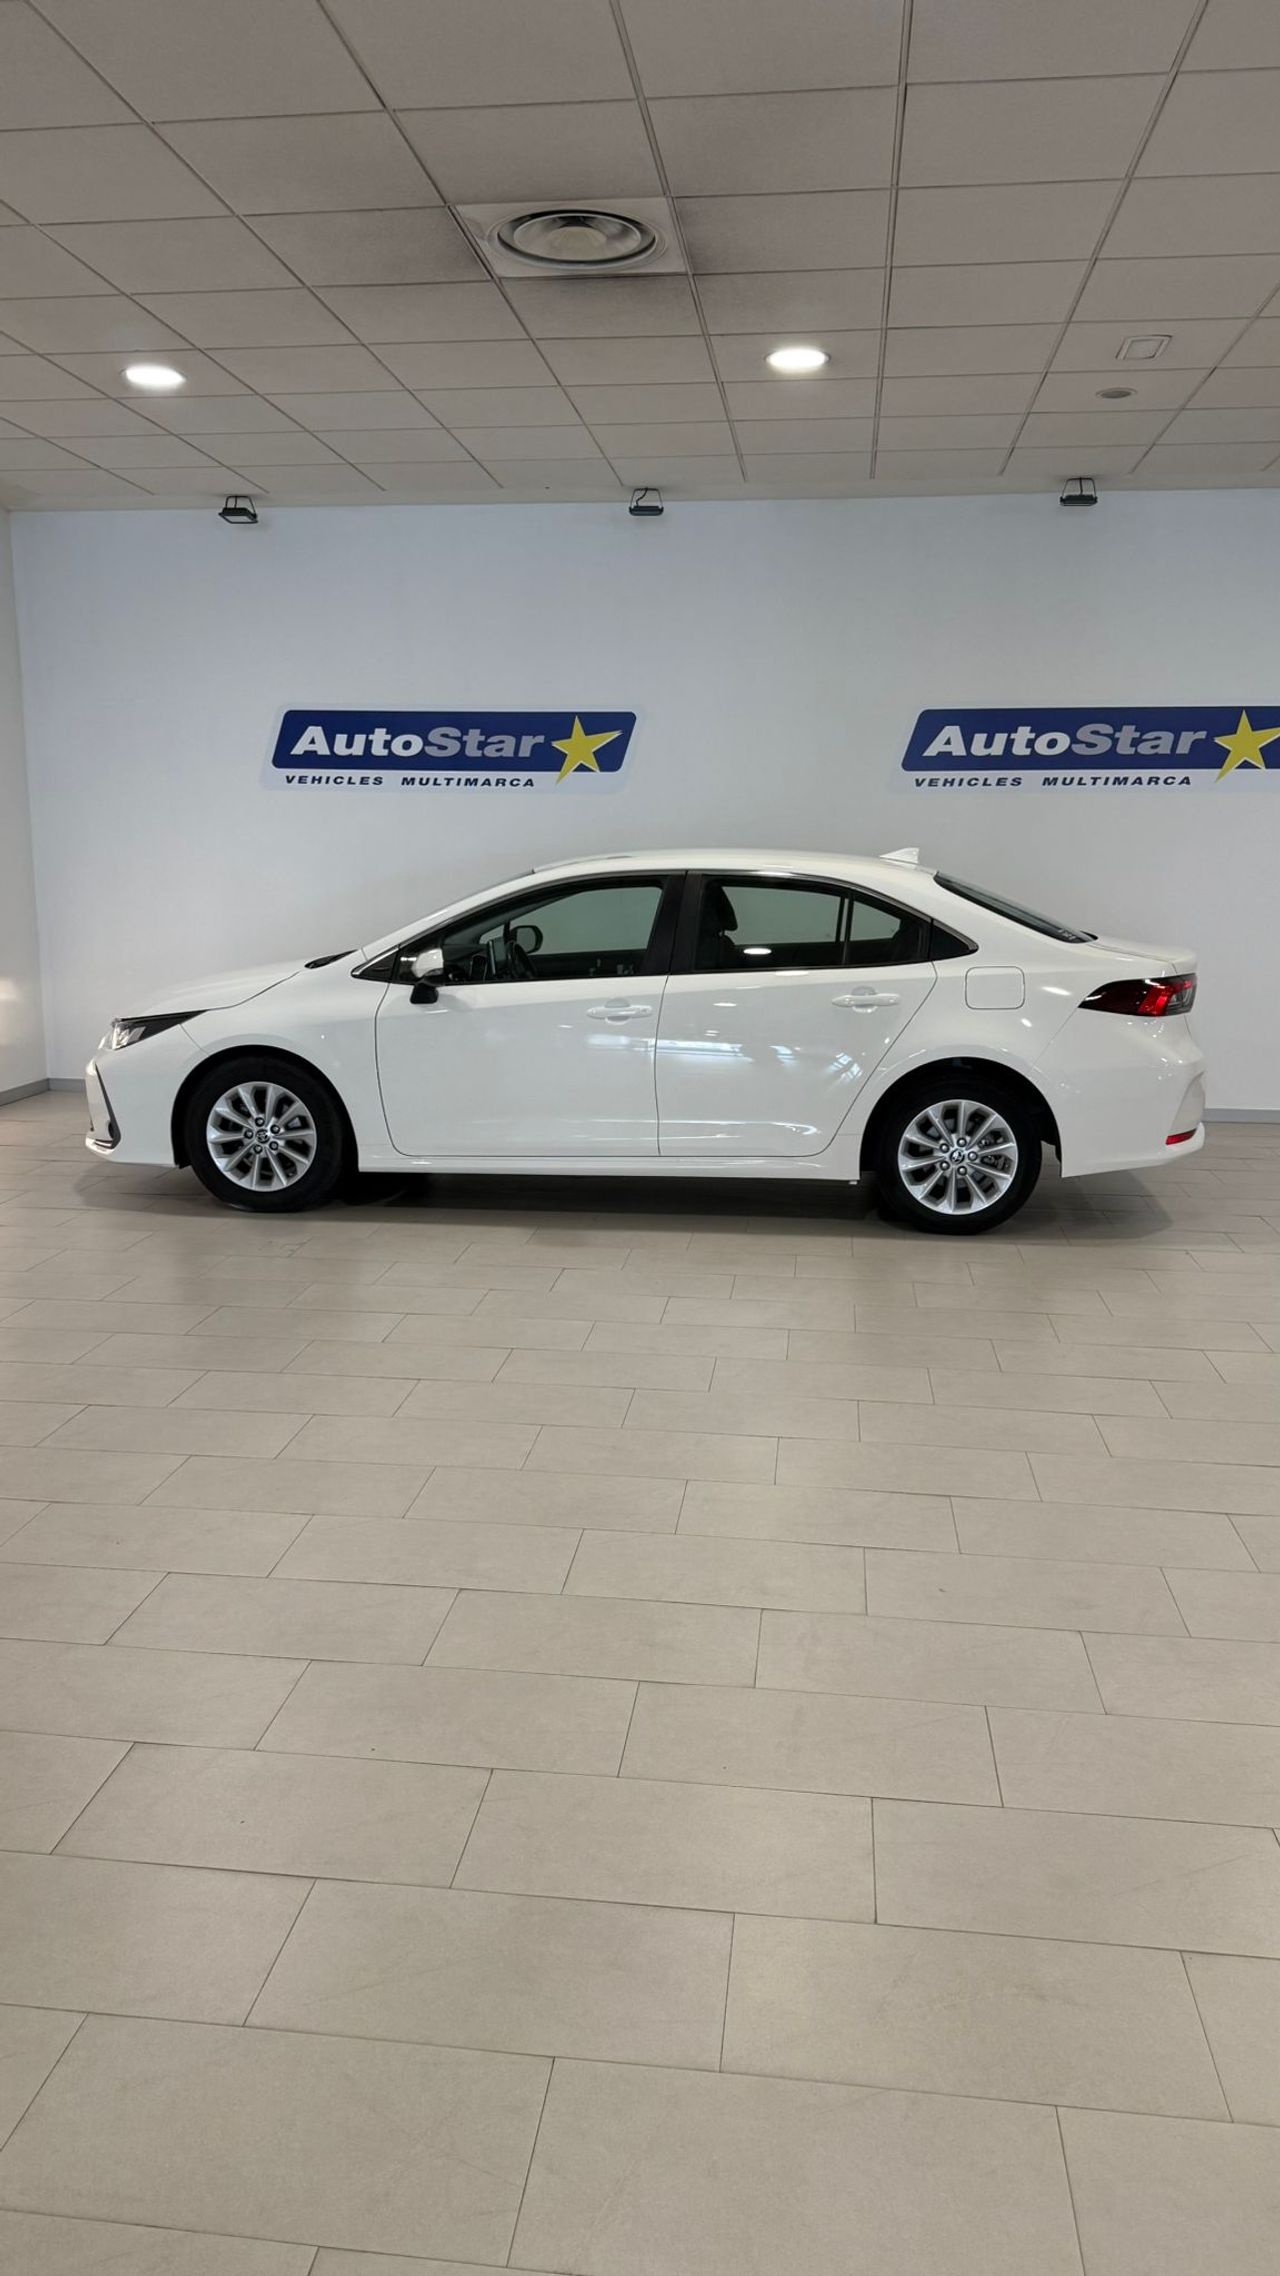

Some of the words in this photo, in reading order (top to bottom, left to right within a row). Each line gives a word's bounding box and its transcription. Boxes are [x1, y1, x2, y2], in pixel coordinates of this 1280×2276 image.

[290, 725, 544, 758] AutoStar
[922, 723, 1207, 757] AutoStar
[285, 774, 384, 786] VEHICLES
[400, 776, 535, 788] MULTIMARCA
[914, 776, 1023, 787] VEHICLES
[1041, 775, 1192, 787] MULTIMARCA
